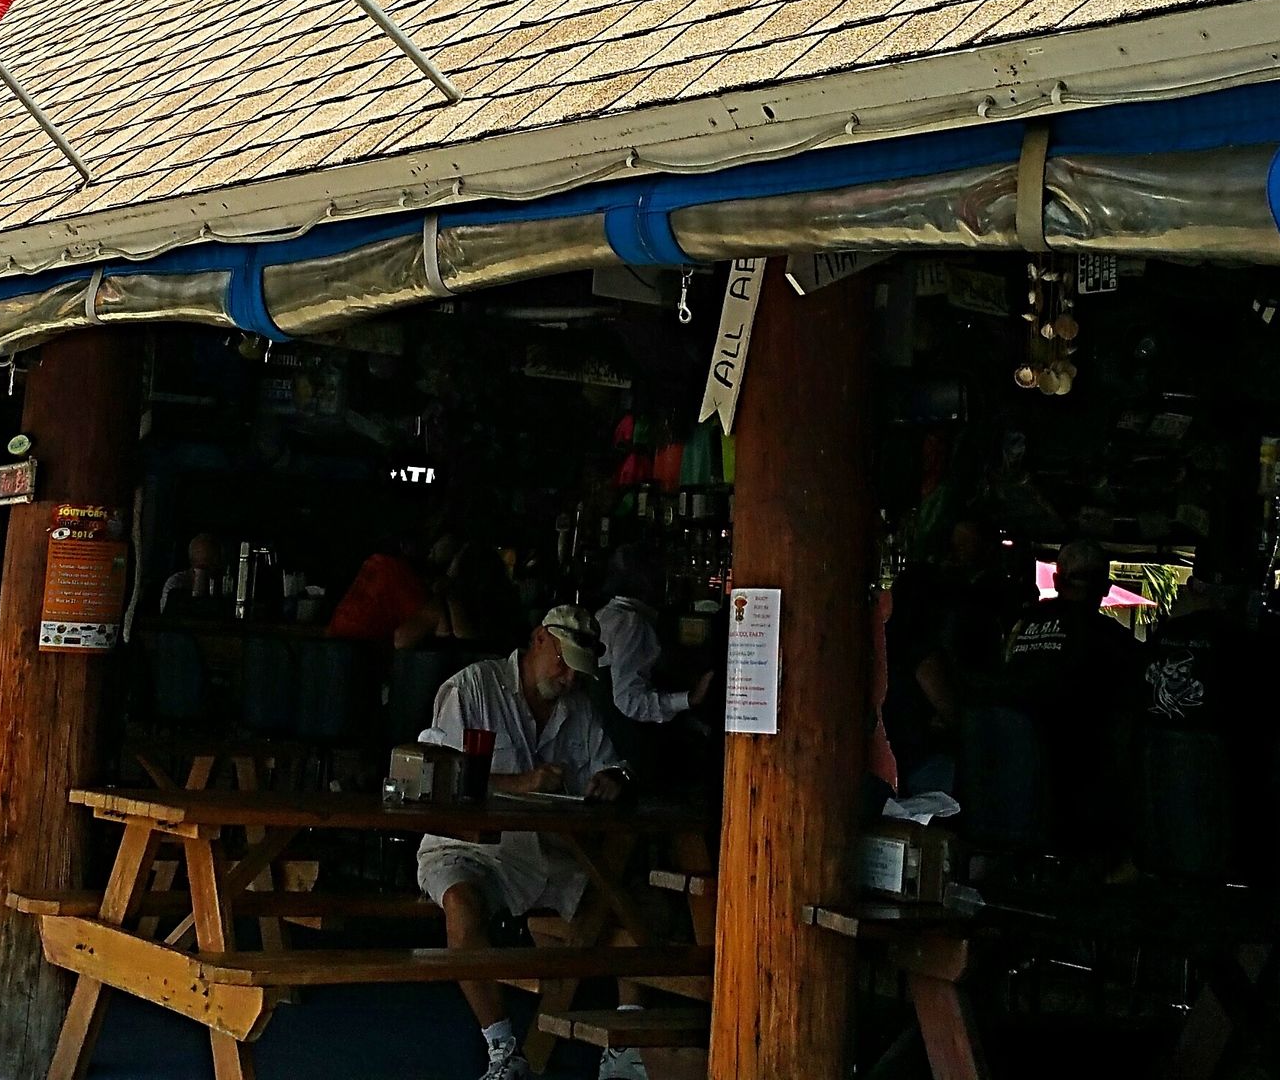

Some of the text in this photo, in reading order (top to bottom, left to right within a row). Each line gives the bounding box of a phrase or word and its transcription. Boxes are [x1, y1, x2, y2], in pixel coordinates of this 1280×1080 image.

[713, 323, 745, 390] ALL
[58, 507, 86, 518] SOUTH
[71, 530, 94, 540] 2016
